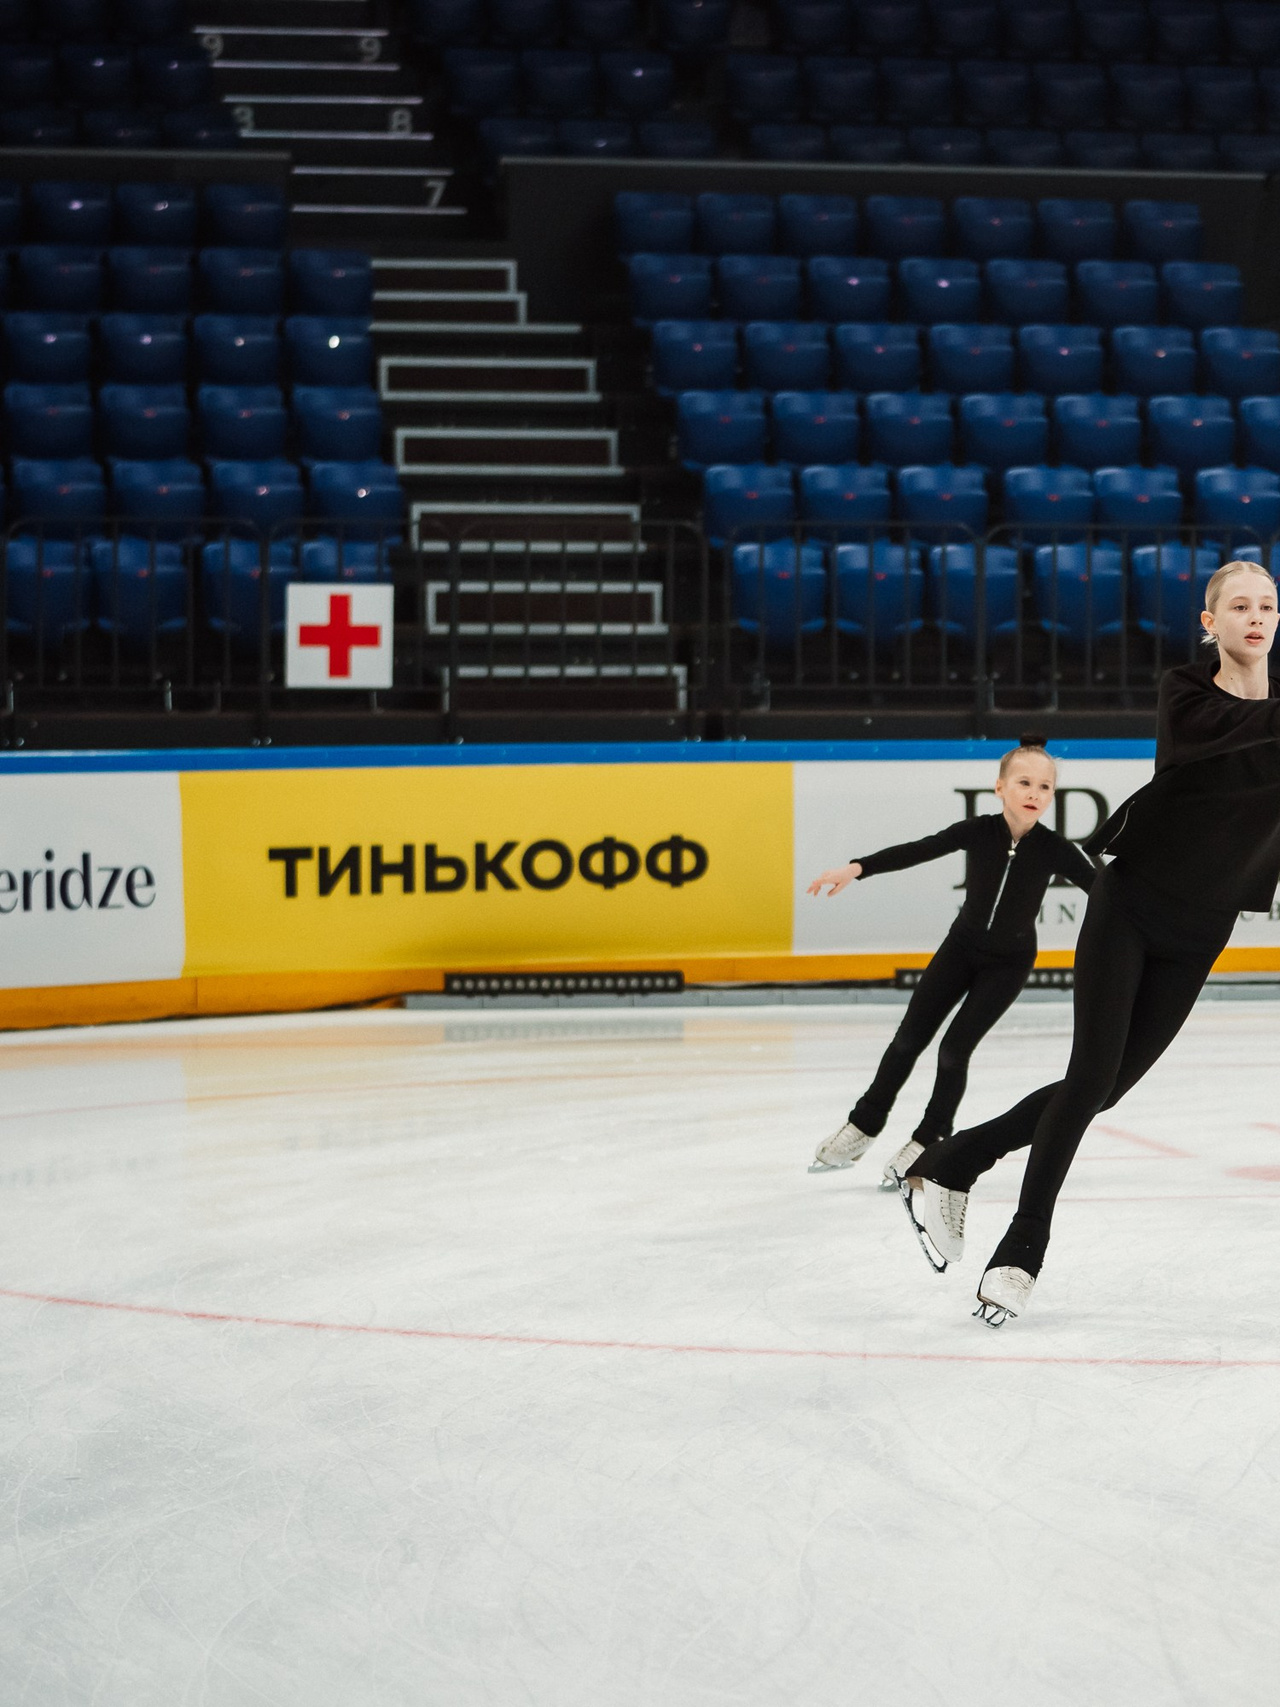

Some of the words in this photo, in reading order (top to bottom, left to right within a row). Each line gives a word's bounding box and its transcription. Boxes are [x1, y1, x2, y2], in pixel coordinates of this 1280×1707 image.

[358, 37, 382, 62] 9
[389, 107, 412, 133] 8
[424, 179, 447, 207] 7
[268, 834, 709, 898] ТИНЬКОФФ
[0, 848, 156, 914] eridze
